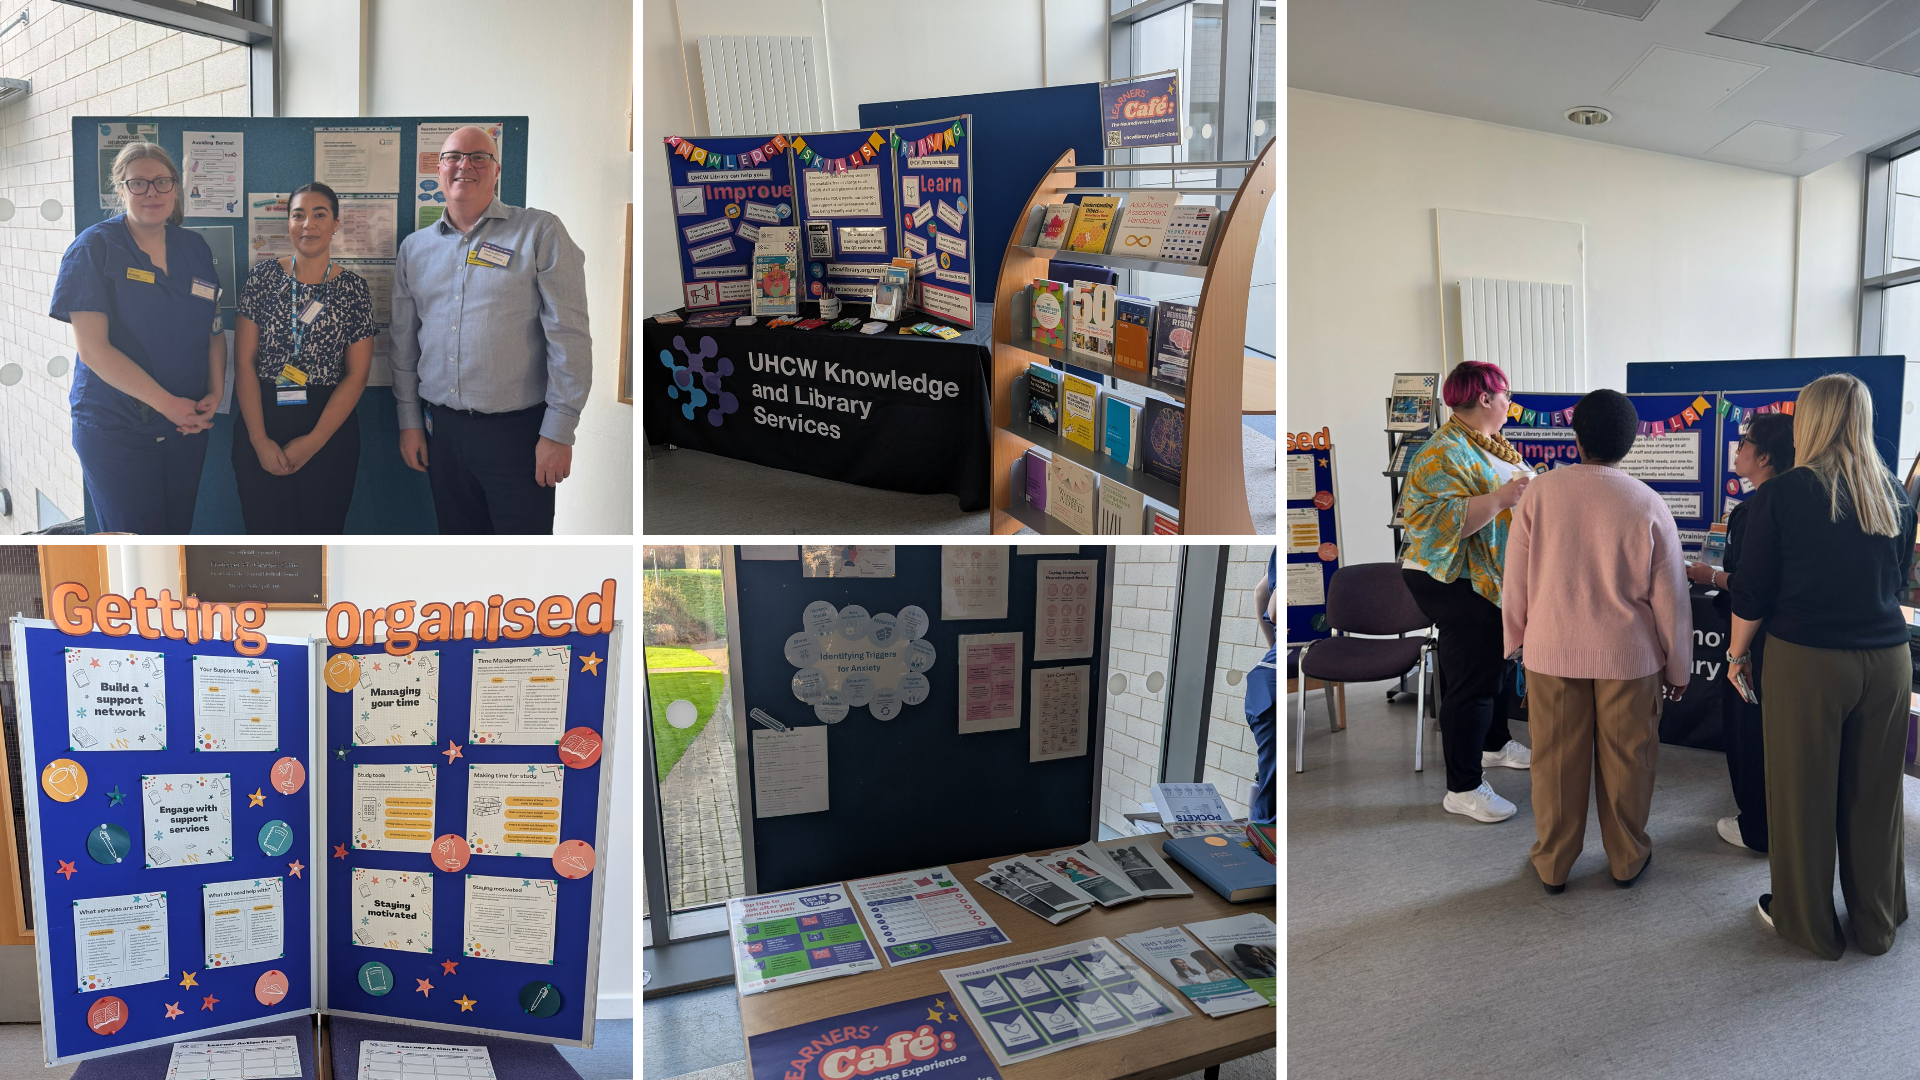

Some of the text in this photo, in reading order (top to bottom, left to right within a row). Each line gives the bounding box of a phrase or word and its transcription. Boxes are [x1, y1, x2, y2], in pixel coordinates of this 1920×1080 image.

[894, 124, 961, 155] TRAINING
[668, 137, 785, 167] KNOWLEDGE
[804, 146, 871, 171] SKILLS
[921, 175, 961, 194] Learn
[706, 185, 793, 204] Improve
[1127, 217, 1162, 225] Handbook
[1073, 284, 1115, 327] 50
[1172, 318, 1194, 329] RISIN
[749, 352, 960, 401] UHCW Knowledge
[752, 384, 872, 420] and Library
[1722, 401, 1789, 420] TRAINI
[754, 406, 841, 440] Services
[1511, 405, 1574, 425] OWLED
[1643, 410, 1694, 434] ILLS
[1518, 442, 1578, 463] Impro
[51, 582, 268, 656] Getting
[326, 578, 617, 656] Organised
[820, 651, 897, 661] Identifying Triggers
[851, 665, 881, 673] Anxiety
[101, 682, 129, 692] Build
[370, 686, 421, 700] Managing
[96, 695, 143, 705] support
[371, 698, 420, 709] your time
[94, 708, 146, 717] network
[160, 804, 218, 816] Engage with
[1176, 814, 1222, 822] POCKETS
[169, 824, 210, 834] services
[170, 815, 209, 825] support
[368, 908, 417, 920] motivated
[374, 900, 411, 911] Staying
[1141, 937, 1187, 948] NHS Talking
[1146, 943, 1182, 952] Therapies
[956, 958, 1040, 979] PRINTABLE AFFIRMATION CARDS
[786, 1025, 879, 1080] EARNERS'
[902, 1054, 967, 1078] Experience
